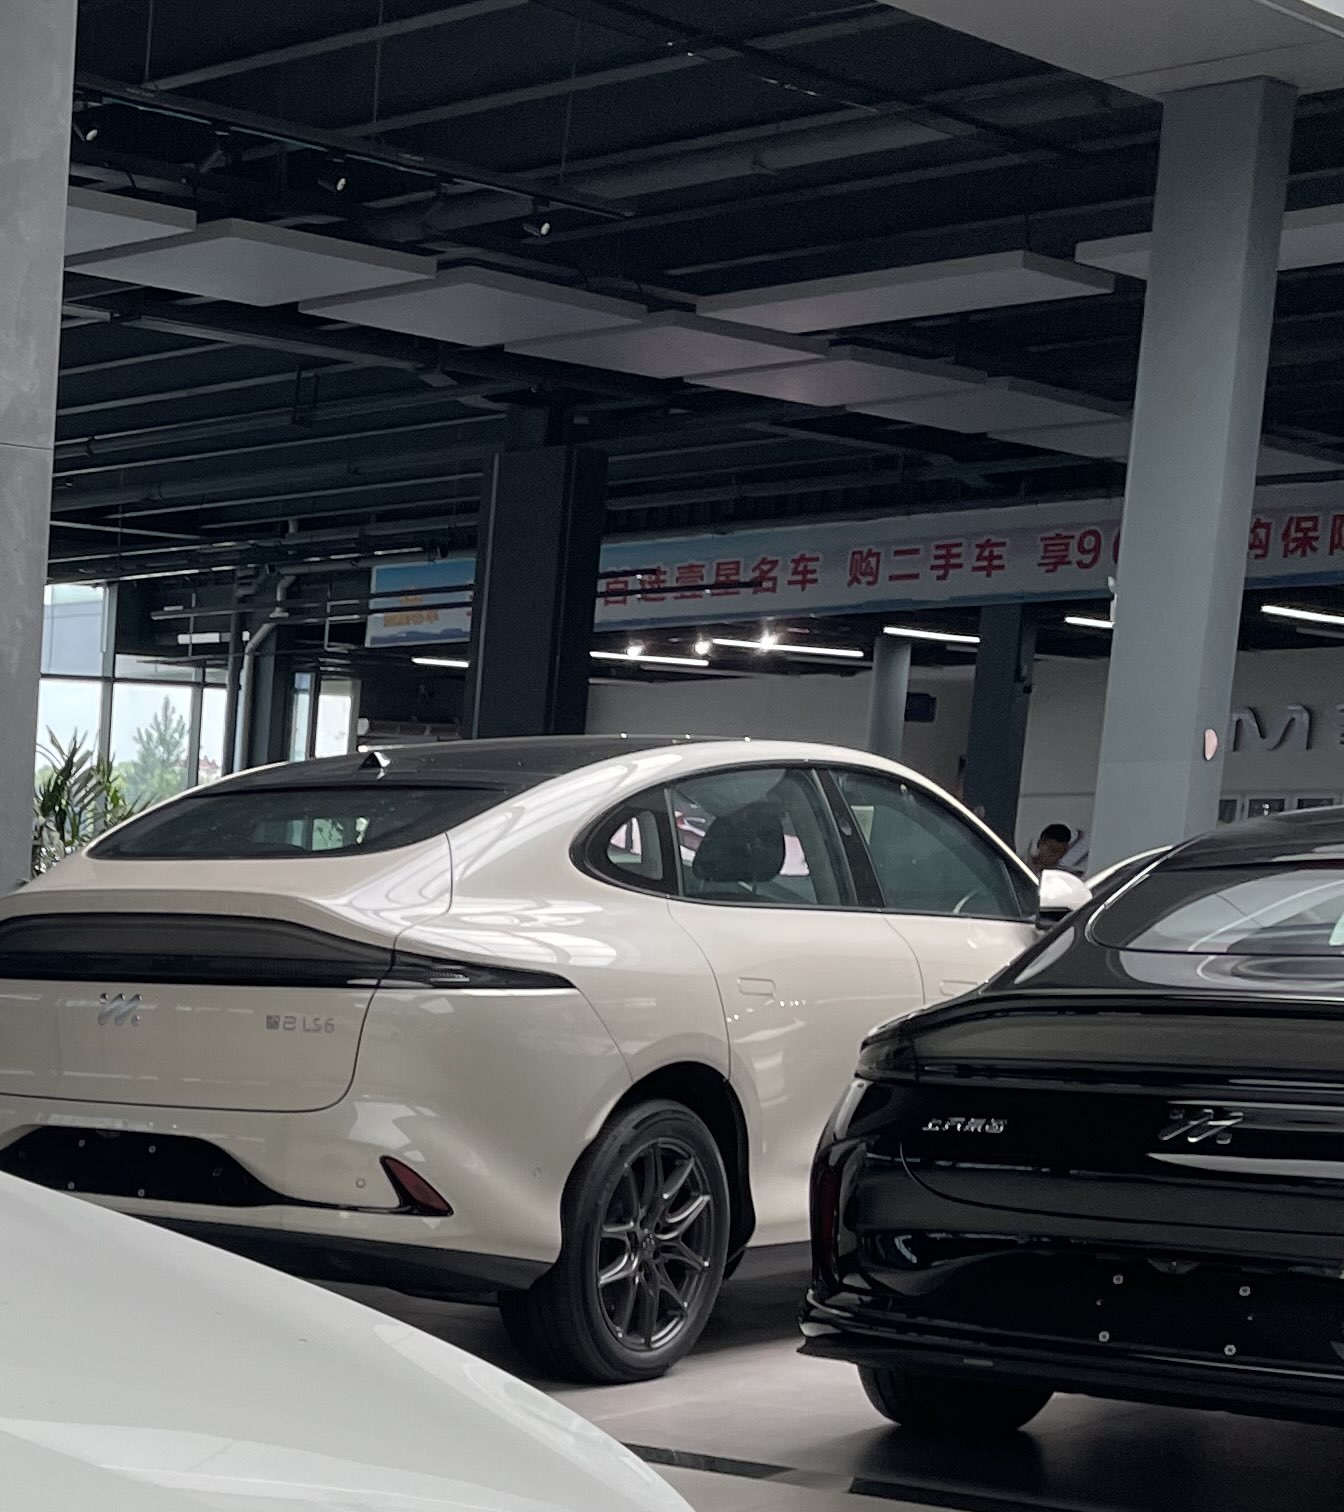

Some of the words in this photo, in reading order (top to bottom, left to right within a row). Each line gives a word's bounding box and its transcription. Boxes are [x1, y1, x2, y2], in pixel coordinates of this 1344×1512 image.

[846, 537, 1008, 588] 购二手车
[1036, 527, 1121, 575] 享9
[302, 1015, 336, 1034] LS6
